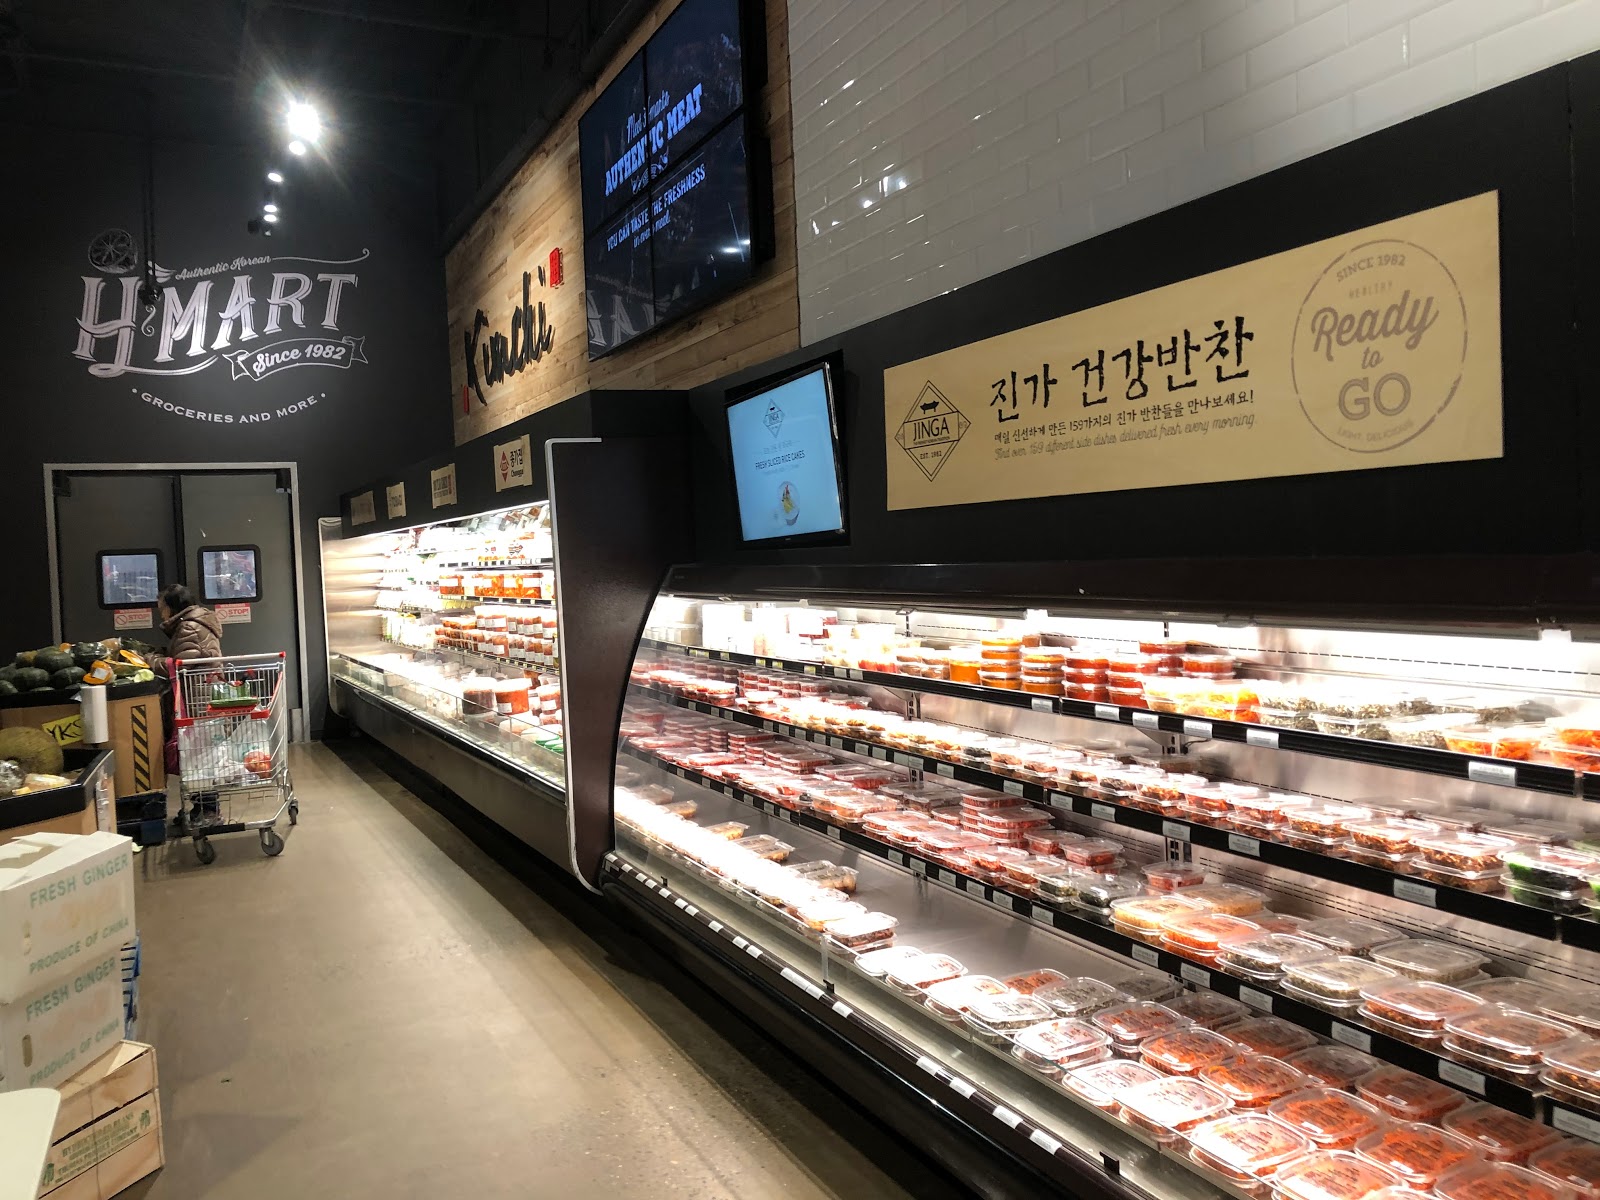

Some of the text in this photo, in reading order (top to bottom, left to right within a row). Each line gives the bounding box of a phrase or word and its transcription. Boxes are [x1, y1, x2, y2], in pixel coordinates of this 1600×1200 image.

[666, 82, 703, 140] MEAT
[607, 232, 618, 252] YOU
[618, 222, 630, 243] CAN
[631, 207, 650, 233] TASTE
[664, 163, 706, 208] FRESHNESS
[175, 255, 272, 280] Authentic Korean
[1336, 253, 1406, 282] SINCE 1982
[1310, 289, 1440, 362] Ready
[253, 342, 347, 377] Since 1982
[989, 315, 1255, 423] 진가 건강반찬
[1360, 346, 1385, 370] to
[140, 391, 318, 424] GROCERIES AND MORE
[994, 389, 1254, 445] 매일 신선하게 만든 159가지의 진가 반찬들을 만나보세요!
[1338, 372, 1412, 421] GO
[913, 416, 950, 442] JINGA
[1076, 434, 1092, 449] side
[1093, 431, 1118, 446] dishes
[1119, 425, 1159, 443] delivered
[1159, 421, 1183, 440] fresh
[1184, 418, 1210, 436] every
[755, 461, 768, 470] FRESH
[781, 453, 791, 463] RICE
[791, 450, 806, 460] CAKES
[29, 853, 129, 909] FRESH GINGER
[29, 917, 129, 975] PRODUCE OF CHINA
[26, 956, 115, 1021] FRESH GINGER
[29, 1047, 77, 1086] PRODUCE
[79, 1037, 92, 1054] OF
